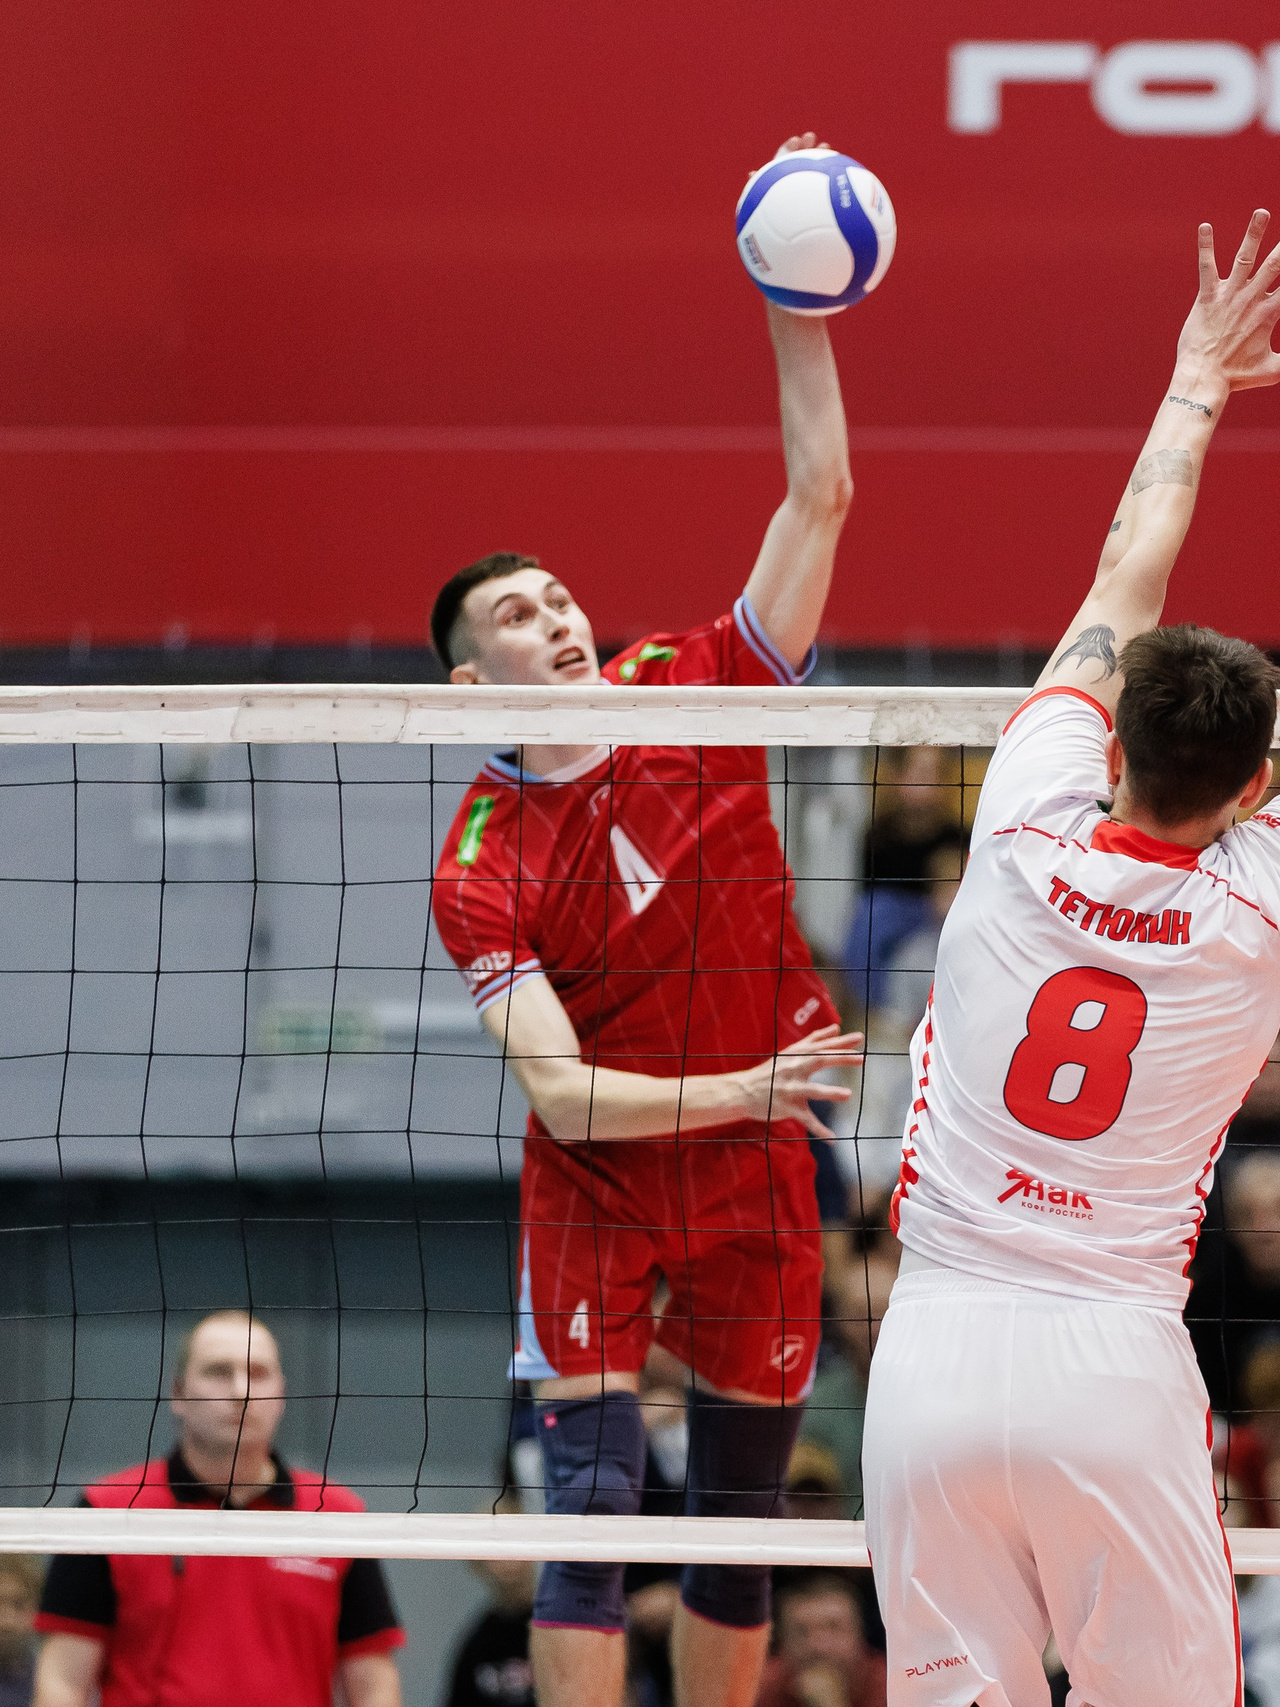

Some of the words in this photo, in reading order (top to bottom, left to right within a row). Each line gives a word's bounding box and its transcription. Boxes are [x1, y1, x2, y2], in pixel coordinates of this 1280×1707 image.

[1047, 875, 1193, 946] ТЕТЮХИН
[1003, 966, 1148, 1141] 8
[1020, 1200, 1046, 1213] КОФЕ
[1048, 1206, 1095, 1221] РОСТЕРС
[568, 1299, 590, 1349] 4
[904, 1654, 969, 1679] PLAYWAY
